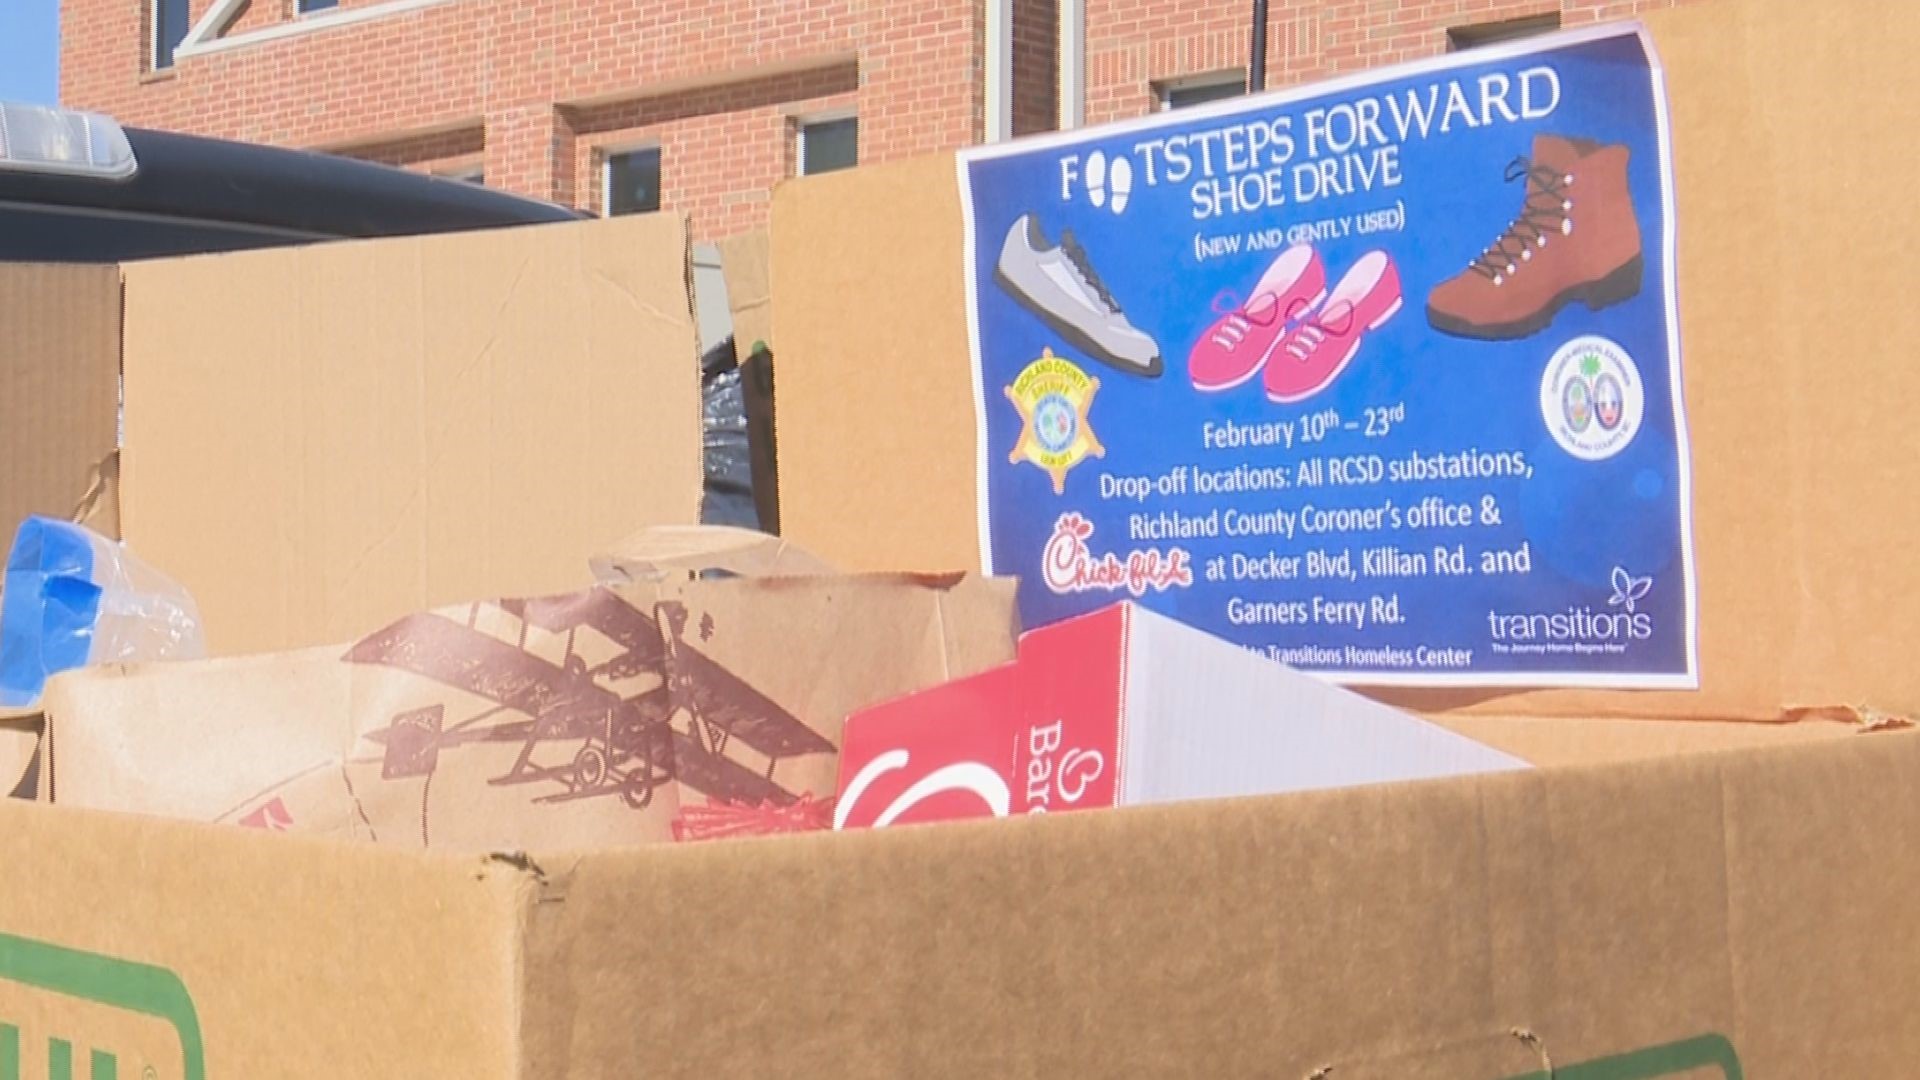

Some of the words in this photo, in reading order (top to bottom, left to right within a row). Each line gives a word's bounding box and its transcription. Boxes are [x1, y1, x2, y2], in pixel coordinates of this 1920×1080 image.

[1306, 66, 1561, 157] FORWARD
[1190, 167, 1285, 219] SHOE
[1292, 144, 1402, 203] DRIVE
[1194, 232, 1241, 262] (NEW
[1246, 228, 1283, 251] AND
[1287, 216, 1352, 244] GENTLY
[1356, 200, 1405, 234] USED)
[1203, 419, 1294, 449] February
[1300, 407, 1340, 443] 10th
[1364, 401, 1405, 437] 23rd
[1100, 465, 1187, 503] Drop-off
[1193, 463, 1291, 494] locations:
[1297, 457, 1322, 487] All
[1329, 454, 1384, 485] RCSD
[1389, 447, 1533, 482] substations,
[1129, 508, 1219, 540] Richland
[1224, 507, 1296, 540] County
[1301, 499, 1401, 533] Coroner’s
[1407, 496, 1472, 529] office
[1480, 494, 1502, 525] &
[1043, 513, 1193, 595] Chick-fil-A
[1205, 554, 1226, 581] at
[1232, 550, 1301, 581] Decker
[1306, 548, 1356, 582] Blvd,
[1362, 545, 1427, 577] Killian
[1434, 543, 1473, 576] Rd.
[1481, 541, 1531, 574] and
[1227, 597, 1308, 625] Garners
[1313, 596, 1366, 630] Ferry
[1371, 592, 1406, 624] Rd.
[1488, 606, 1652, 639] transitions
[1268, 645, 1342, 666] Transitions
[1345, 644, 1413, 665] Homeless
[1416, 645, 1473, 667] Center
[1492, 643, 1508, 653] The
[1512, 643, 1545, 655] Journey
[1547, 642, 1573, 652] Home
[1026, 719, 1062, 815] Bar
